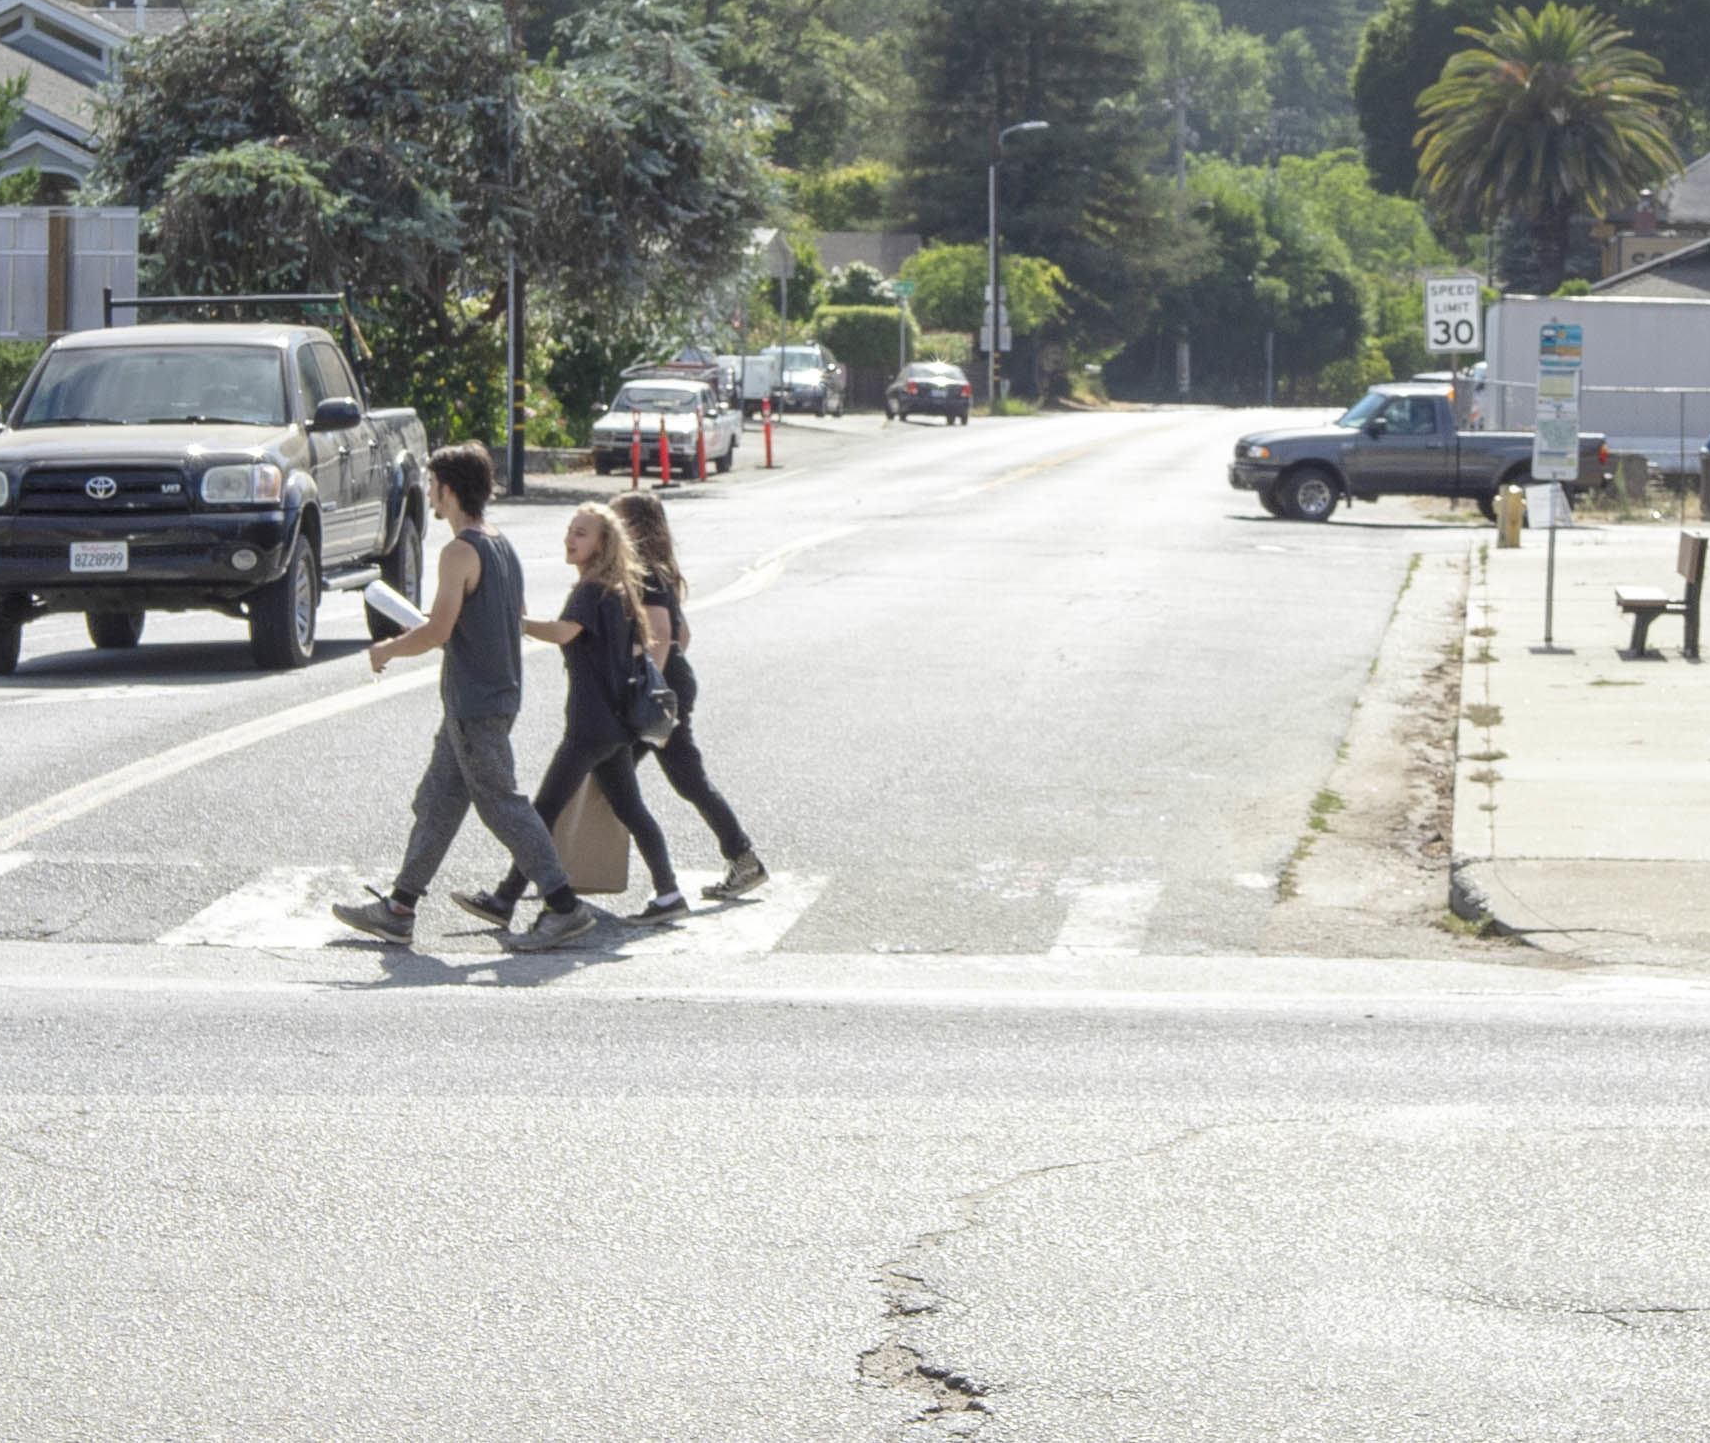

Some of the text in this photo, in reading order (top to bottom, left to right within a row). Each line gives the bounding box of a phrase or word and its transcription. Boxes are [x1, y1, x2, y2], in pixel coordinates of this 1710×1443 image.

[1431, 284, 1475, 296] SPEED
[1434, 301, 1469, 314] LIMIT
[1433, 319, 1474, 346] 30
